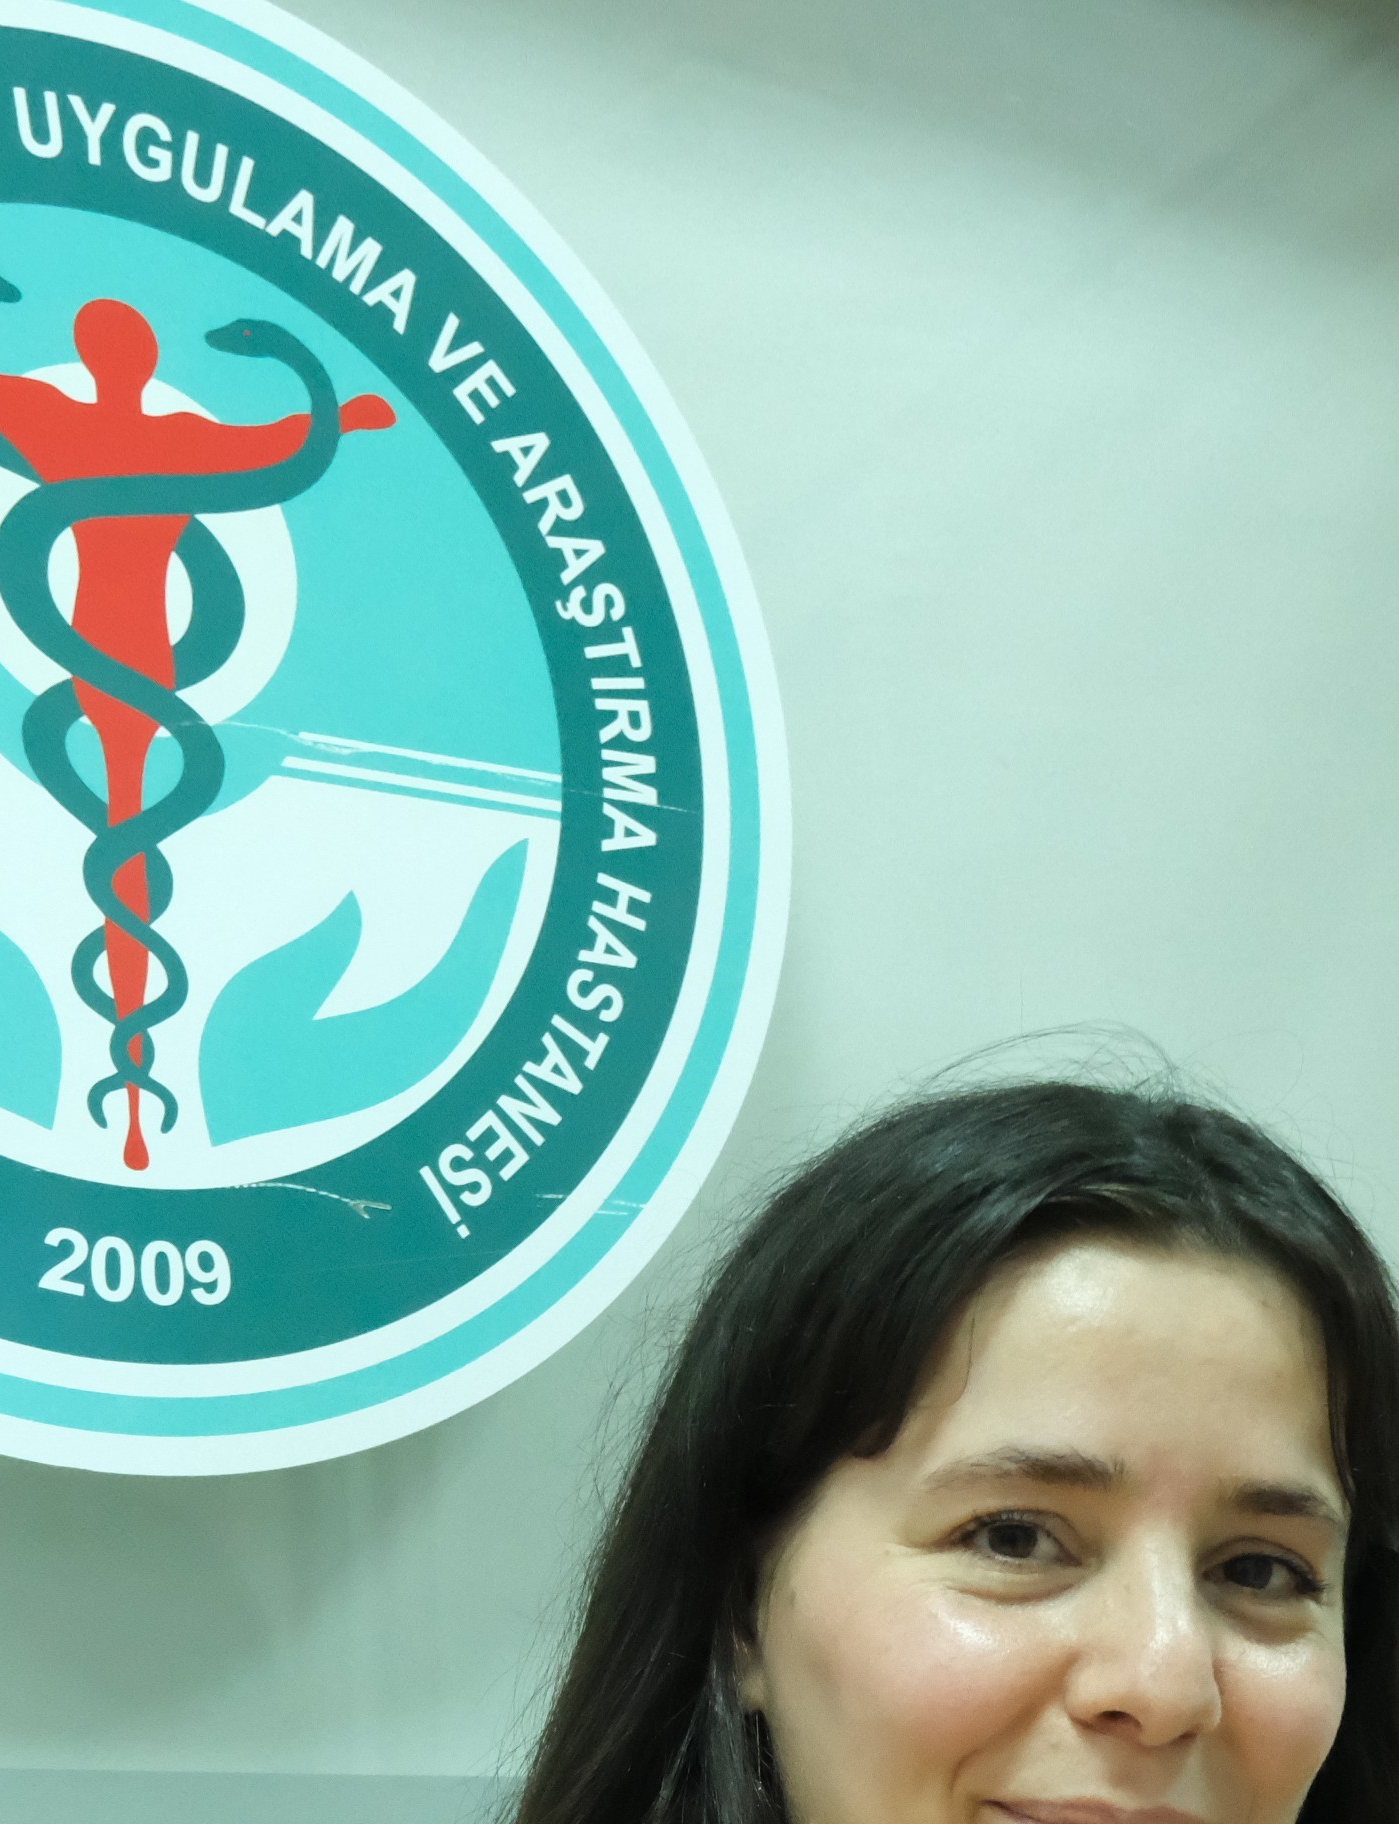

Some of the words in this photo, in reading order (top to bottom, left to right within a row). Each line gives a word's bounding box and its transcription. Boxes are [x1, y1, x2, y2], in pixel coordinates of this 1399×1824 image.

[12, 86, 417, 335] UYGULAMA
[428, 312, 517, 425] VE
[490, 431, 659, 852] ARAŞTIRMA
[419, 872, 652, 1239] HASTANESİ
[38, 1227, 232, 1307] 2009
